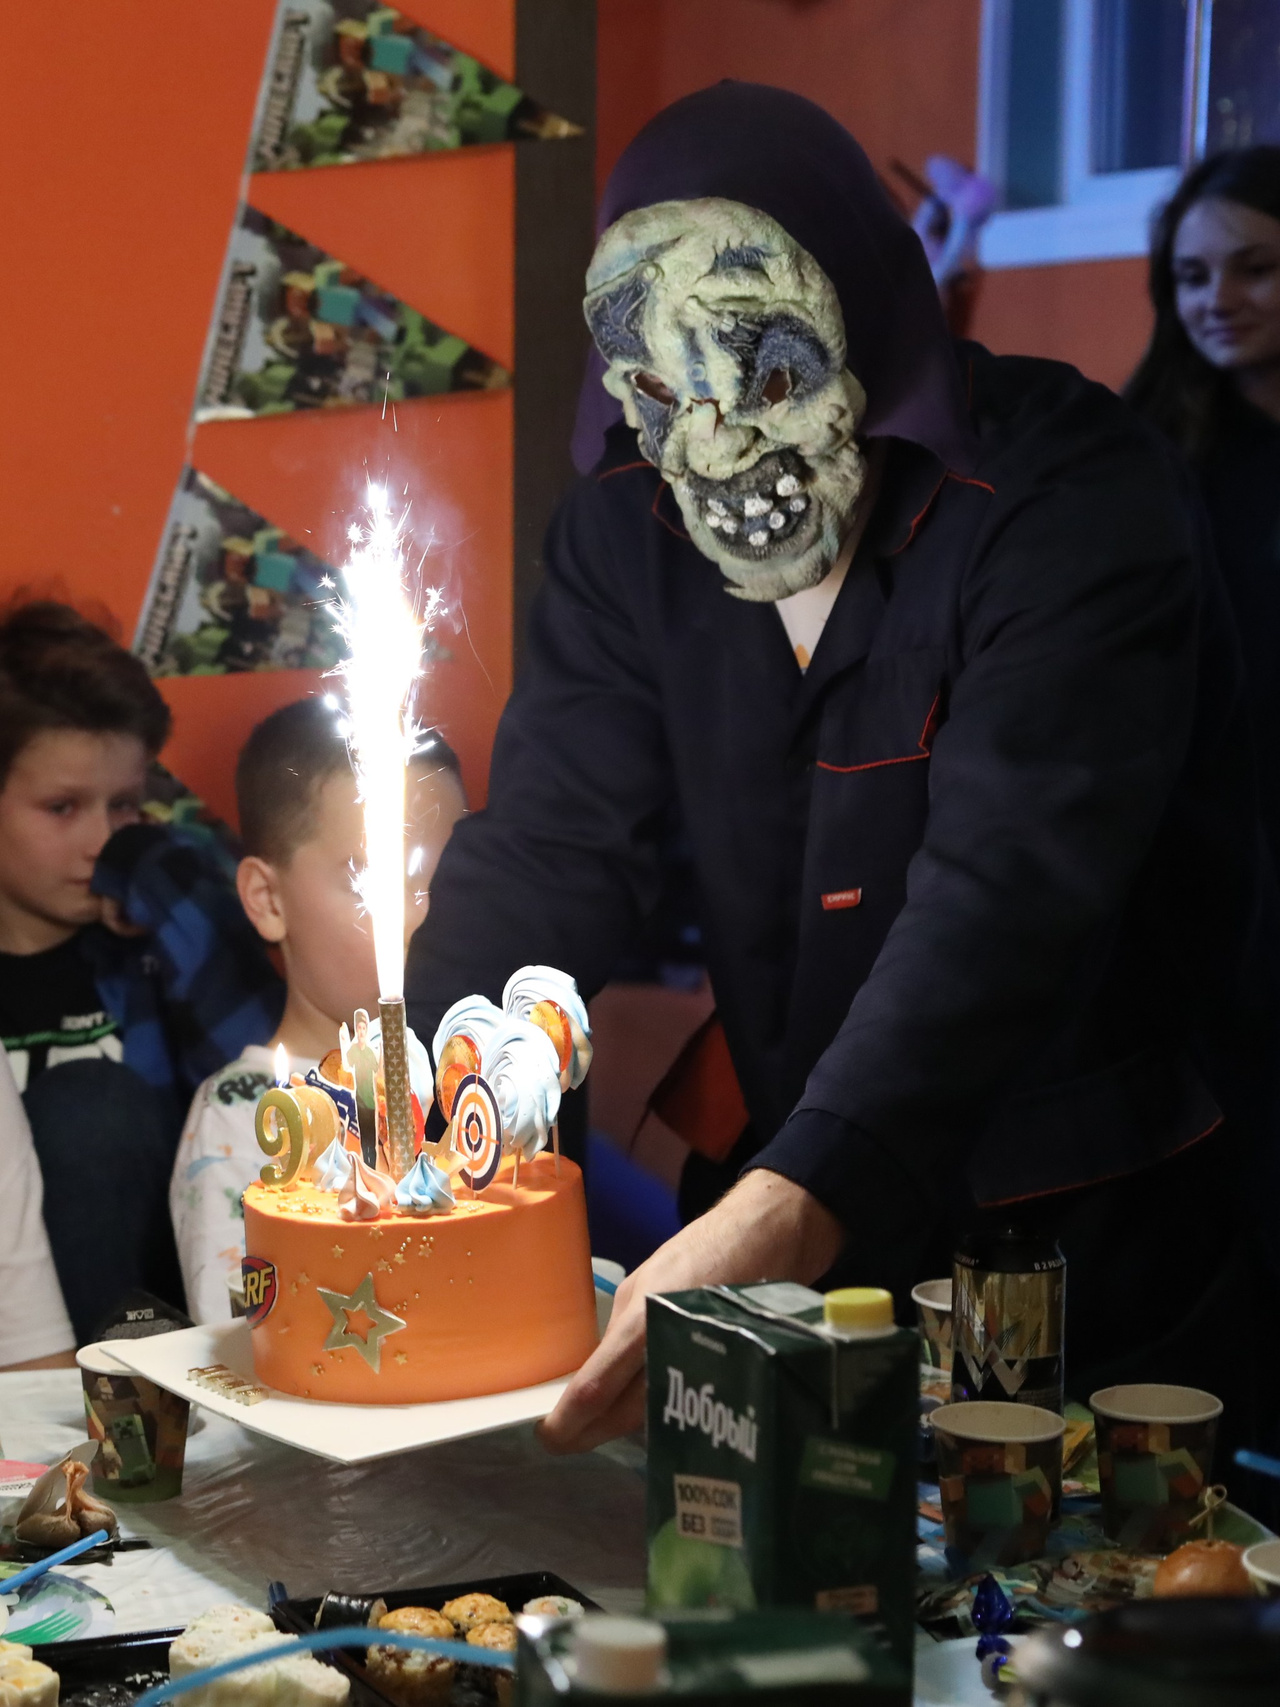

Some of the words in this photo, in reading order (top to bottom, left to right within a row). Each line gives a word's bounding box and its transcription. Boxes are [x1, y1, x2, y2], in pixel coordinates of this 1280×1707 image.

[255, 1088, 306, 1189] 9
[664, 1367, 758, 1462] Добрый
[682, 1512, 705, 1534] БЕЗ
